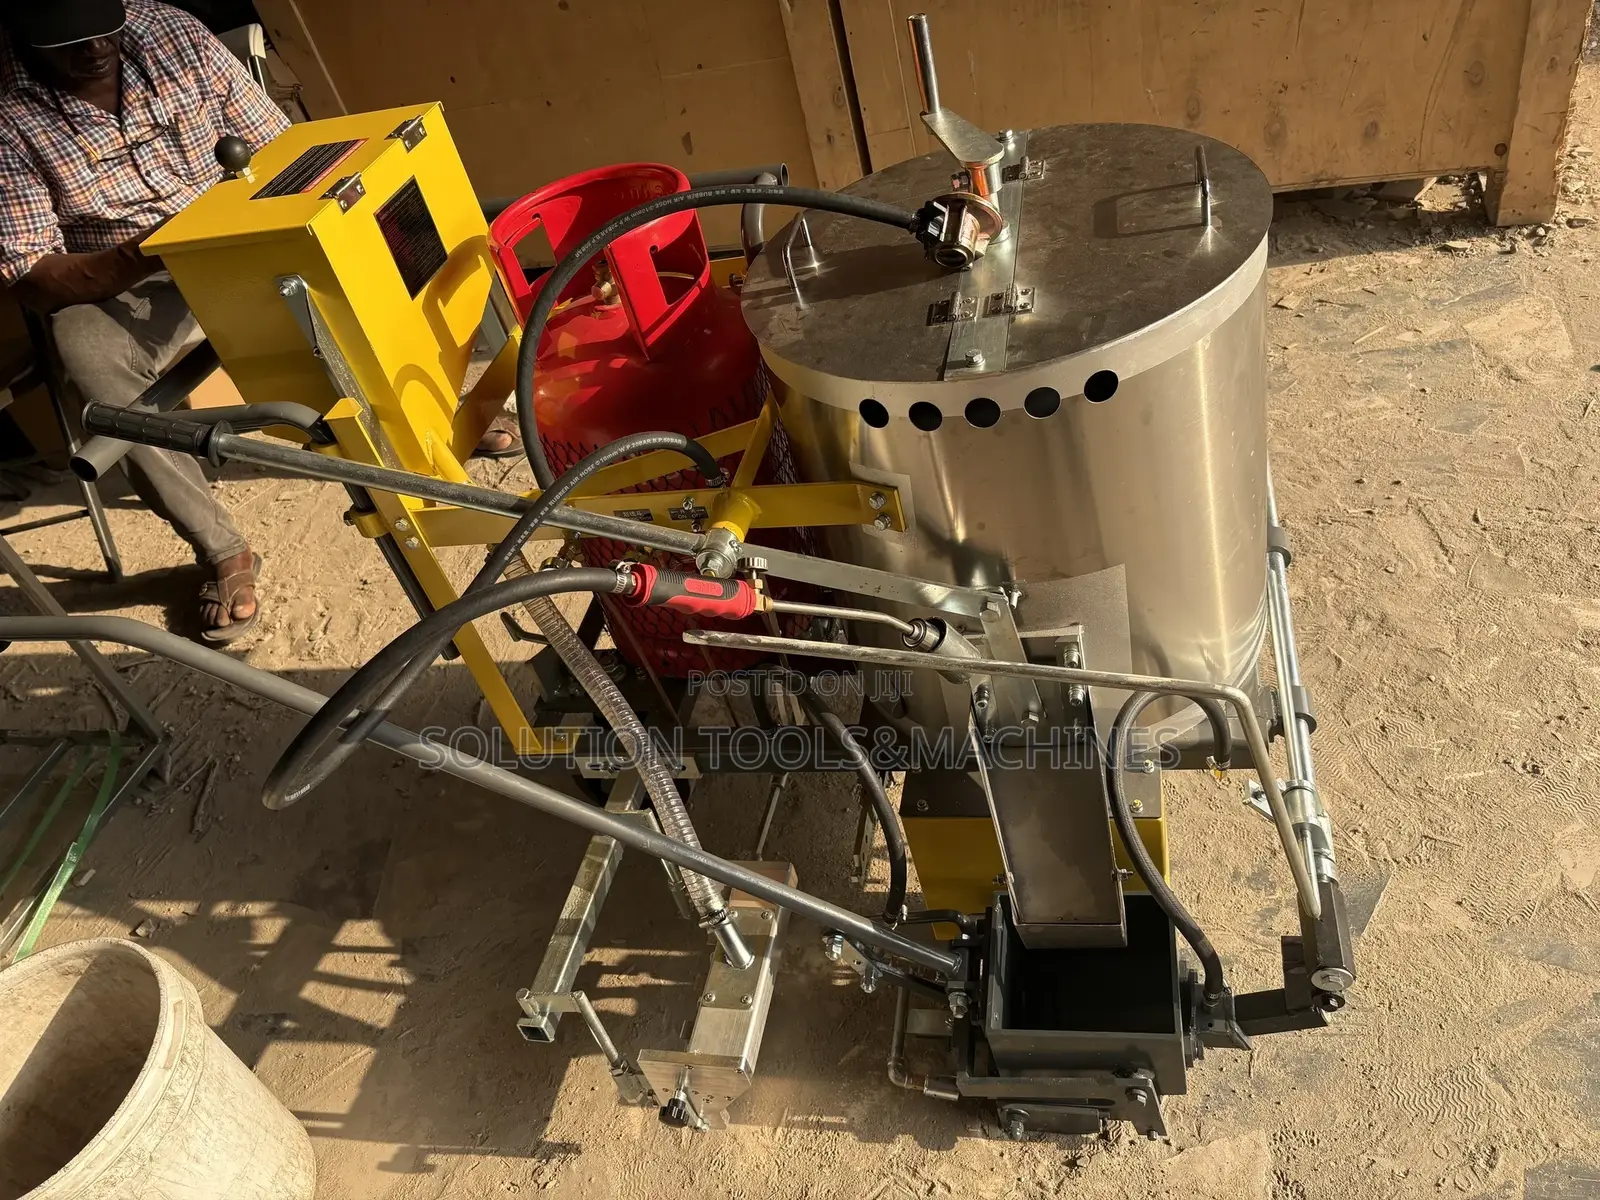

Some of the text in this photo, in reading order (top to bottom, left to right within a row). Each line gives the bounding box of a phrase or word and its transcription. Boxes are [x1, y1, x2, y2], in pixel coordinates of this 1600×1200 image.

[687, 190, 712, 200] RUBBER
[548, 485, 569, 506] RUBBER
[569, 476, 580, 487] AIR
[580, 464, 595, 478] HOSE
